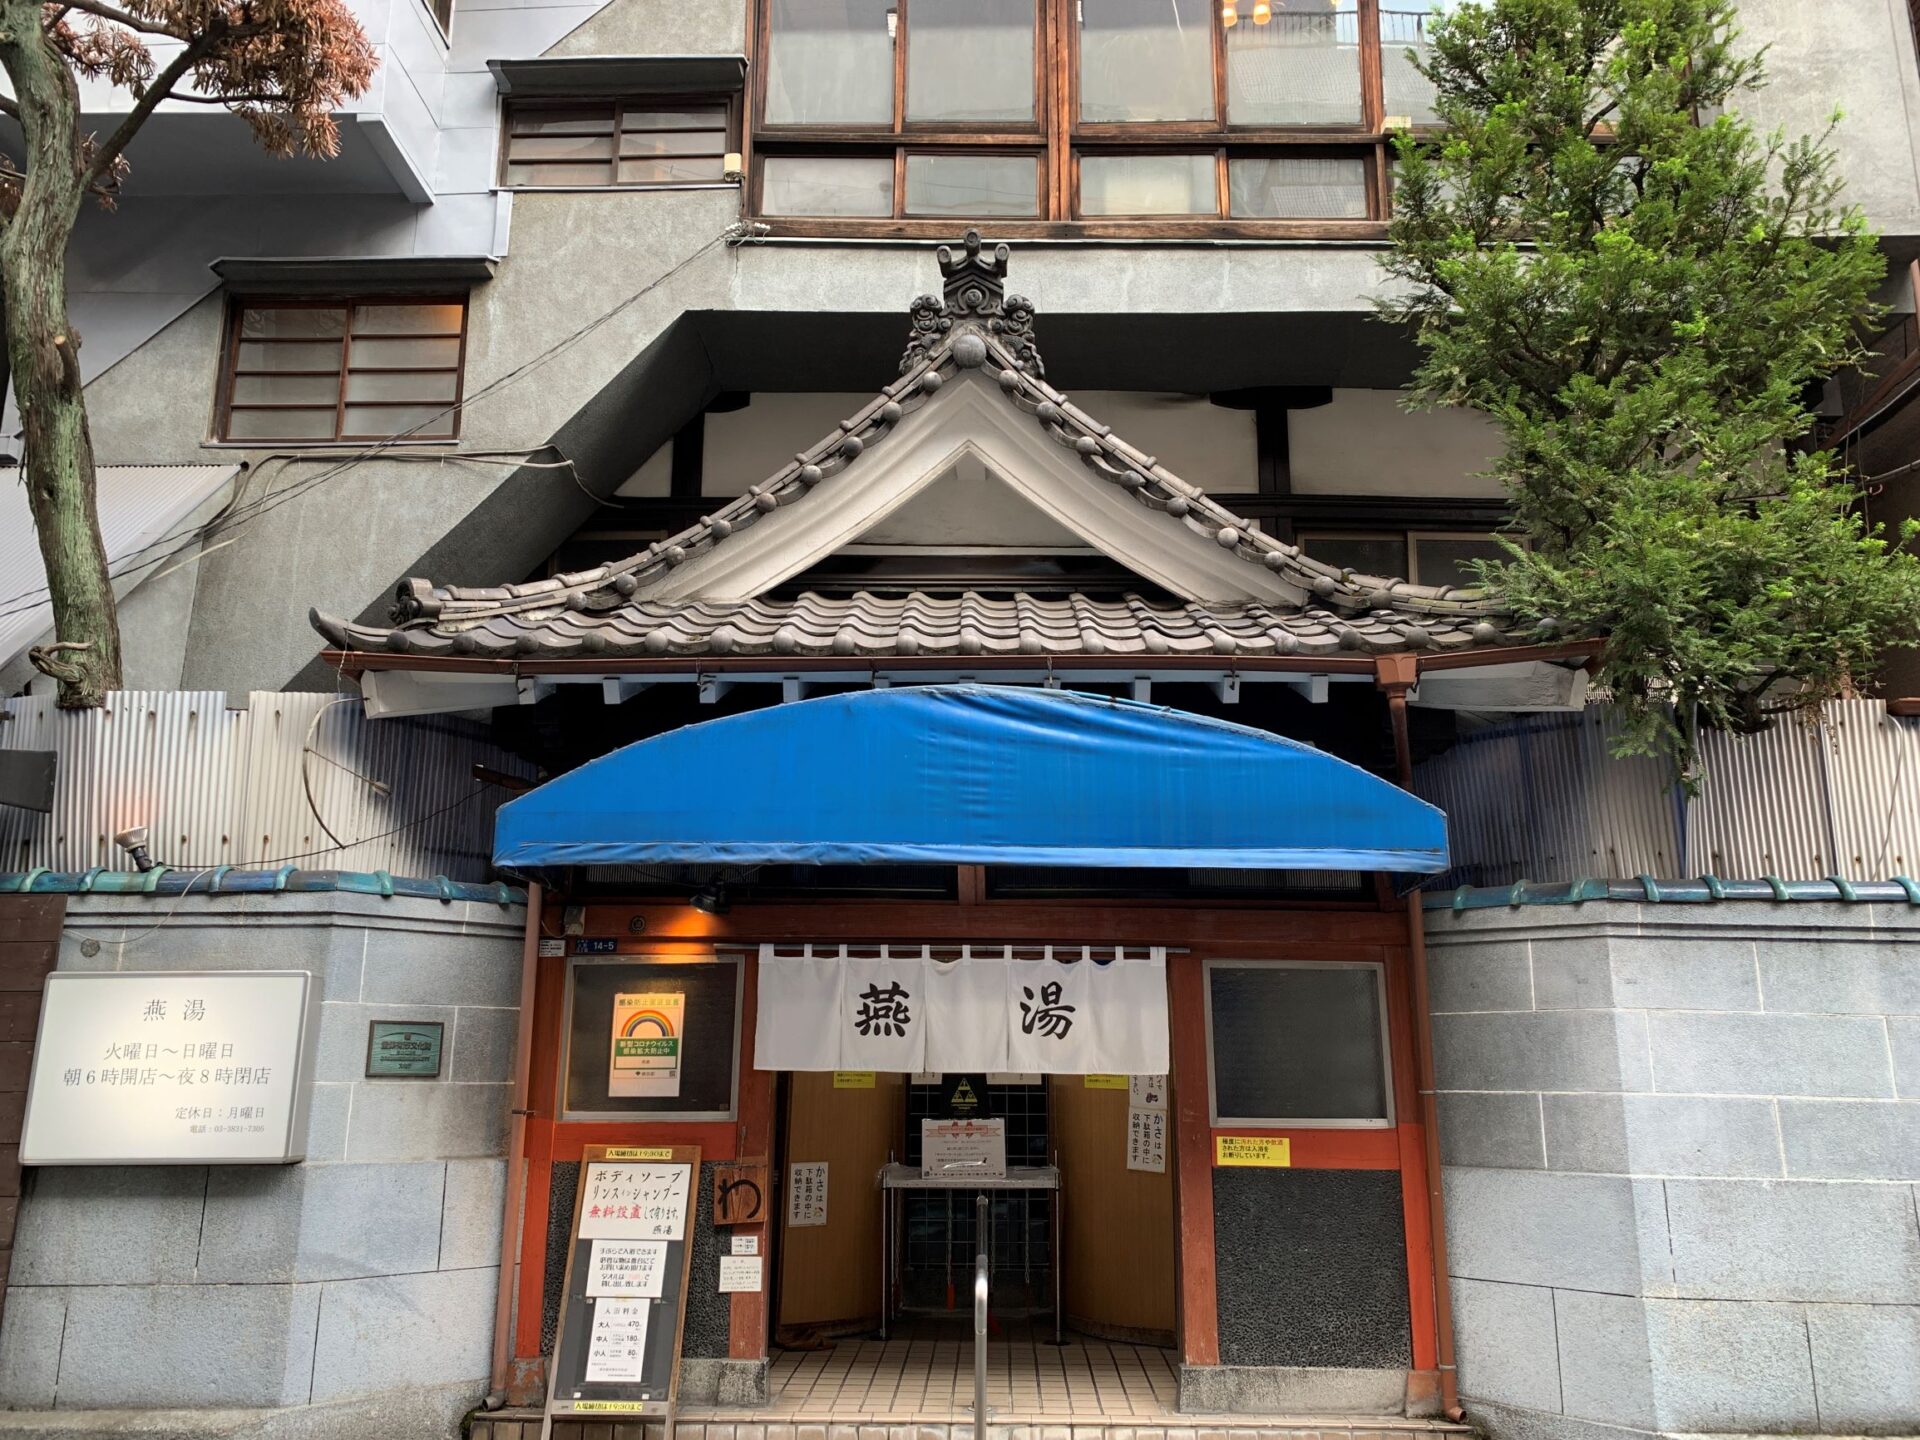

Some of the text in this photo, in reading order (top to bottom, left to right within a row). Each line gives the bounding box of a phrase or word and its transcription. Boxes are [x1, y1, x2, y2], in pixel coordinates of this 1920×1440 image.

[594, 941, 614, 950] 14-5
[1132, 1113, 1140, 1162] 収納できます
[1142, 1114, 1151, 1164] 下駄箱の中に
[1153, 1113, 1164, 1150] かさは
[595, 1170, 683, 1183] ボディソープ
[793, 1168, 802, 1219] 収納できます
[815, 1166, 825, 1202] かさは
[718, 1178, 762, 1220] わ
[604, 1307, 639, 1315] 入浴料金
[594, 1350, 606, 1358] 小人
